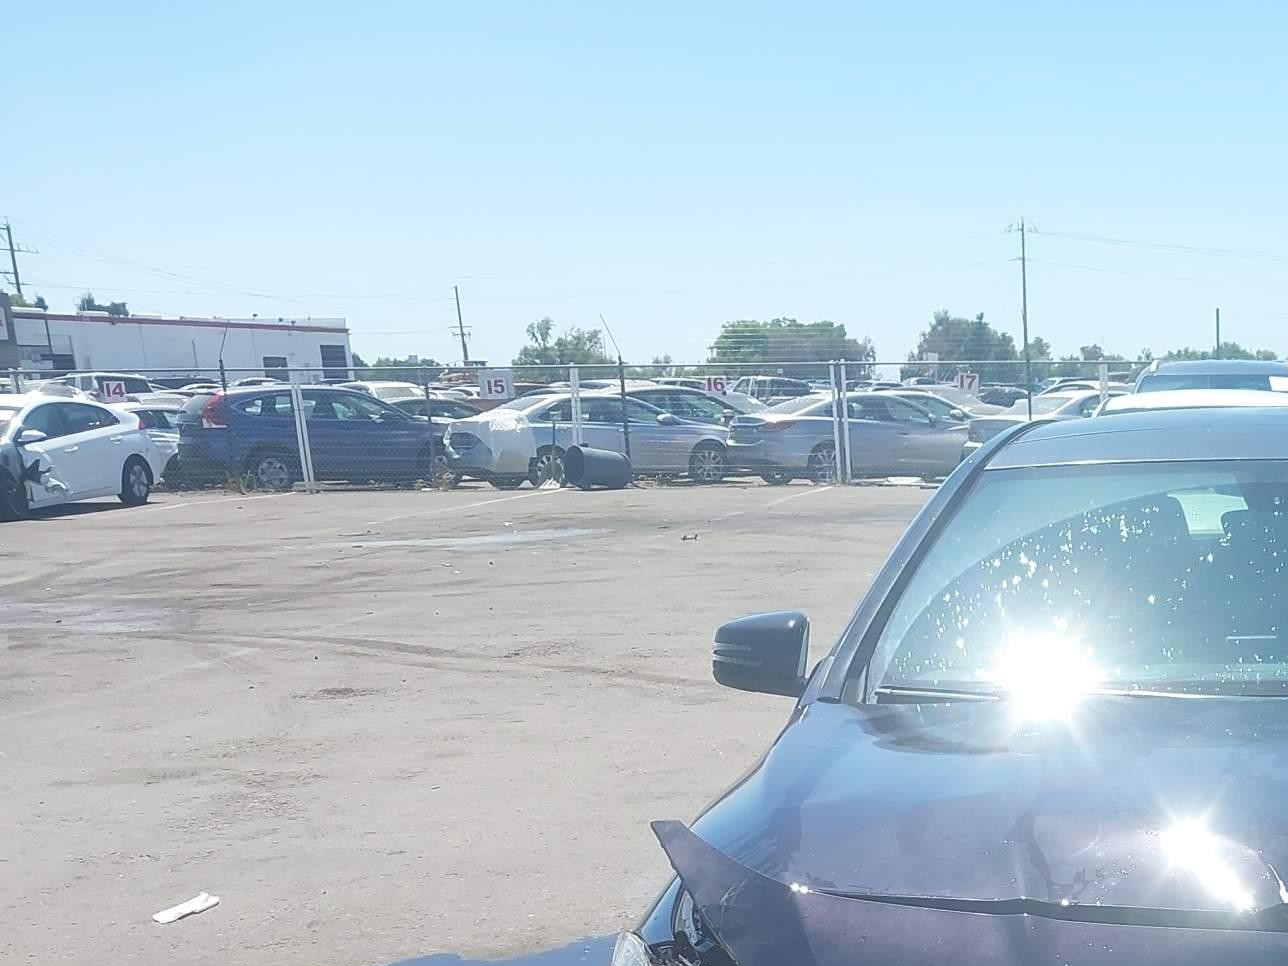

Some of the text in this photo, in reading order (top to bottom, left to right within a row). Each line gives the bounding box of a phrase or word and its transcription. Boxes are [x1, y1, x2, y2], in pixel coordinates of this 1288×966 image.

[488, 379, 504, 394] 15
[707, 377, 724, 392] 16
[959, 375, 976, 389] 17
[105, 383, 124, 397] 14
